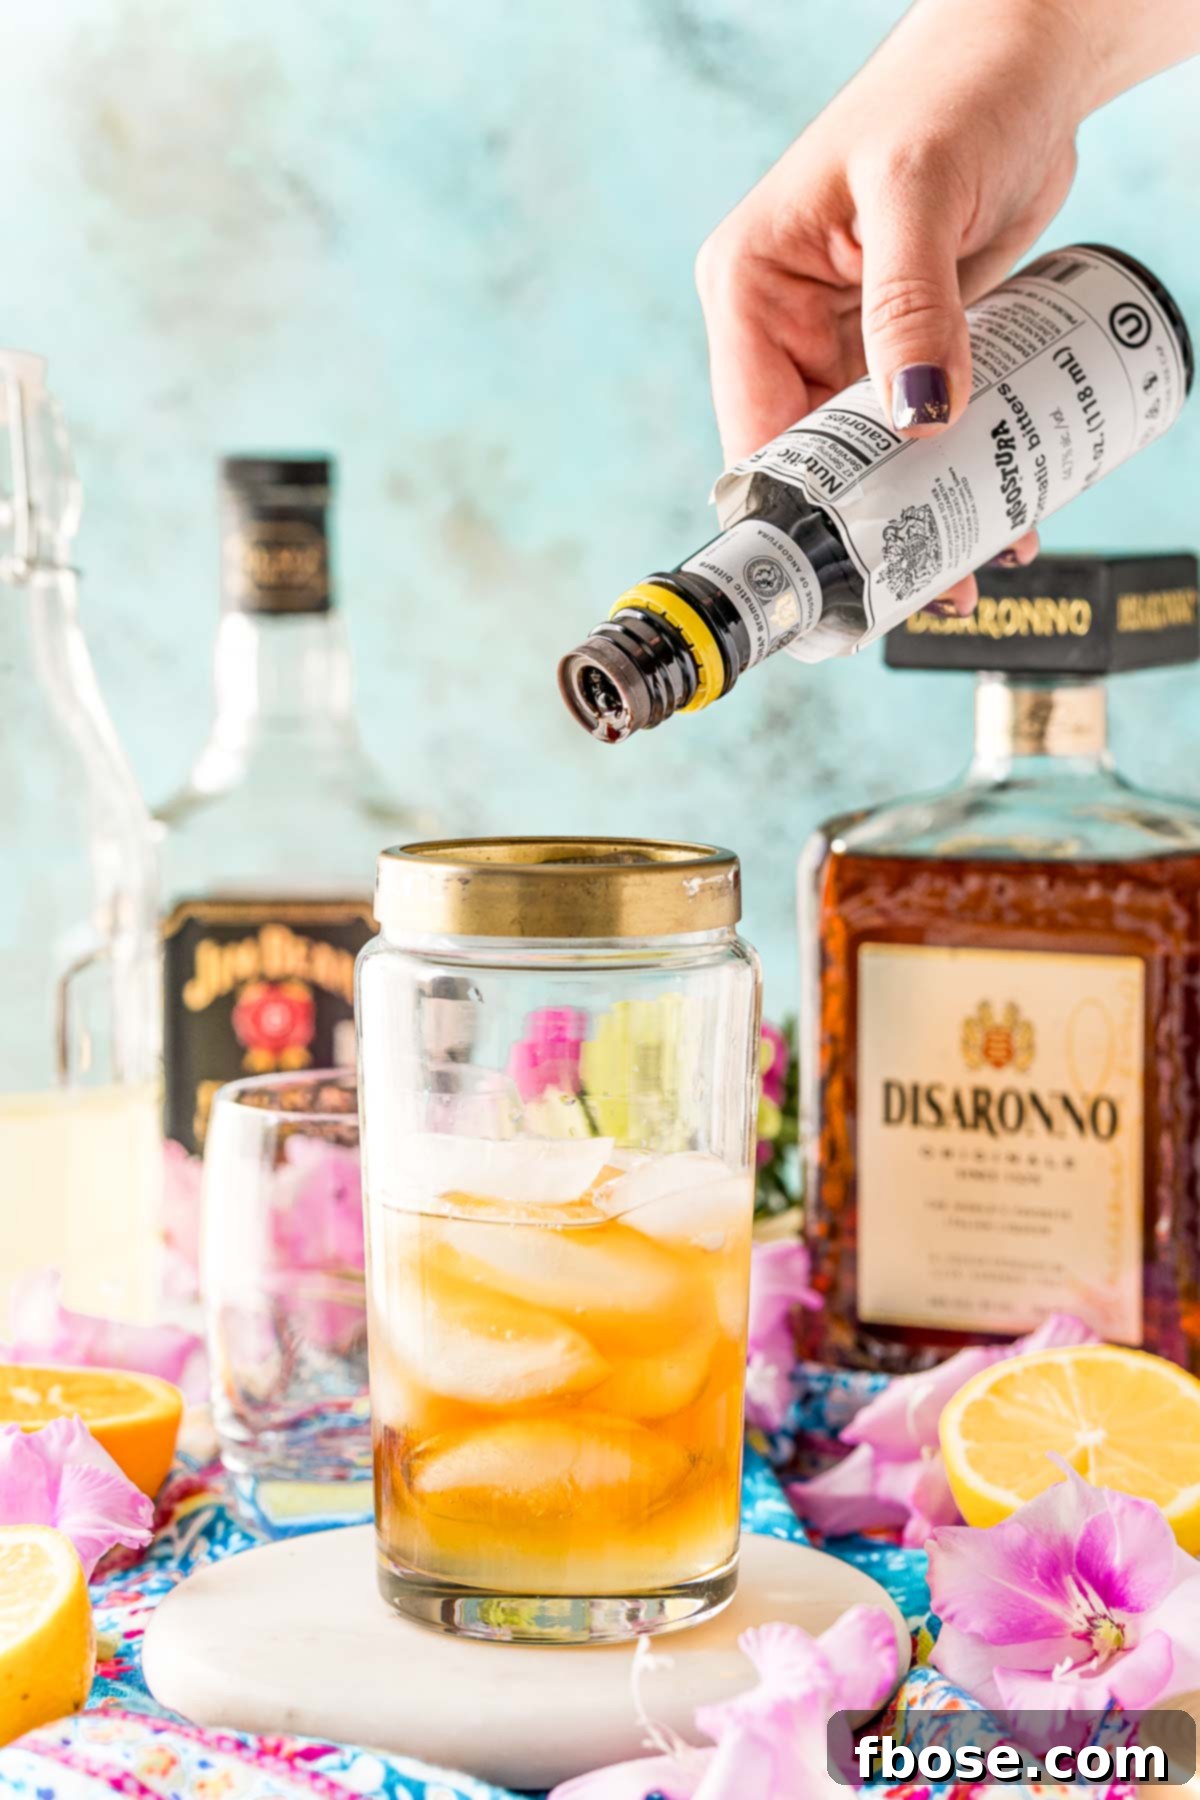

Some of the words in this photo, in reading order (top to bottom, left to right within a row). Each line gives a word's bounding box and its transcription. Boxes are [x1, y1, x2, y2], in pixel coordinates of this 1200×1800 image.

[1116, 311, 1141, 339] U
[1053, 346, 1086, 384] mL)
[997, 382, 1040, 450] bitters
[1077, 385, 1104, 432] (118
[824, 413, 892, 451] Calories
[827, 442, 862, 471] Serving
[842, 468, 854, 478] 47
[990, 419, 1026, 529] ANGOSTURA
[757, 529, 802, 571] ANGOSTURA
[698, 560, 733, 583] bitters
[798, 576, 809, 588] OF
[734, 583, 763, 631] aromatic
[805, 590, 813, 618] HOUSE
[882, 1080, 1119, 1142] DISARONNO
